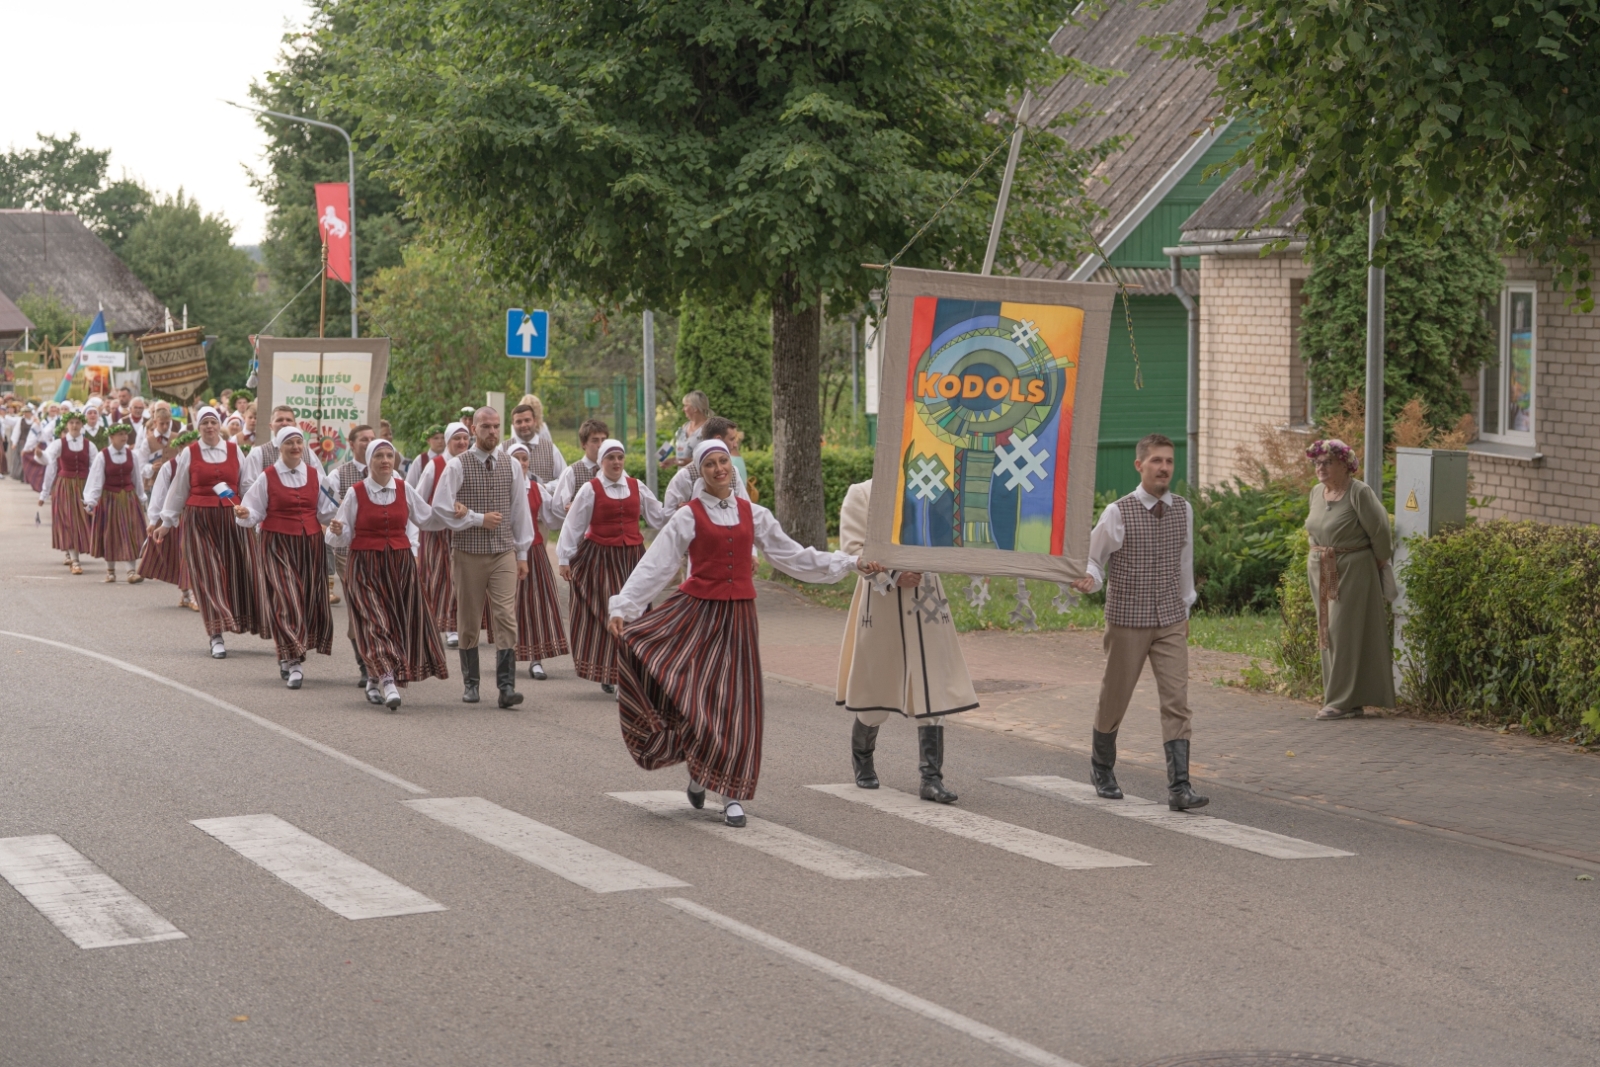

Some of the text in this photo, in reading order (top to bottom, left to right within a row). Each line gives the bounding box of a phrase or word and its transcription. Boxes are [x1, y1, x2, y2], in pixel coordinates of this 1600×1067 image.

[291, 372, 351, 383] JAUNIEŠU
[305, 386, 335, 395] DEJU
[917, 371, 1046, 404] KODOLS
[285, 395, 354, 407] KOLEKTĪVS
